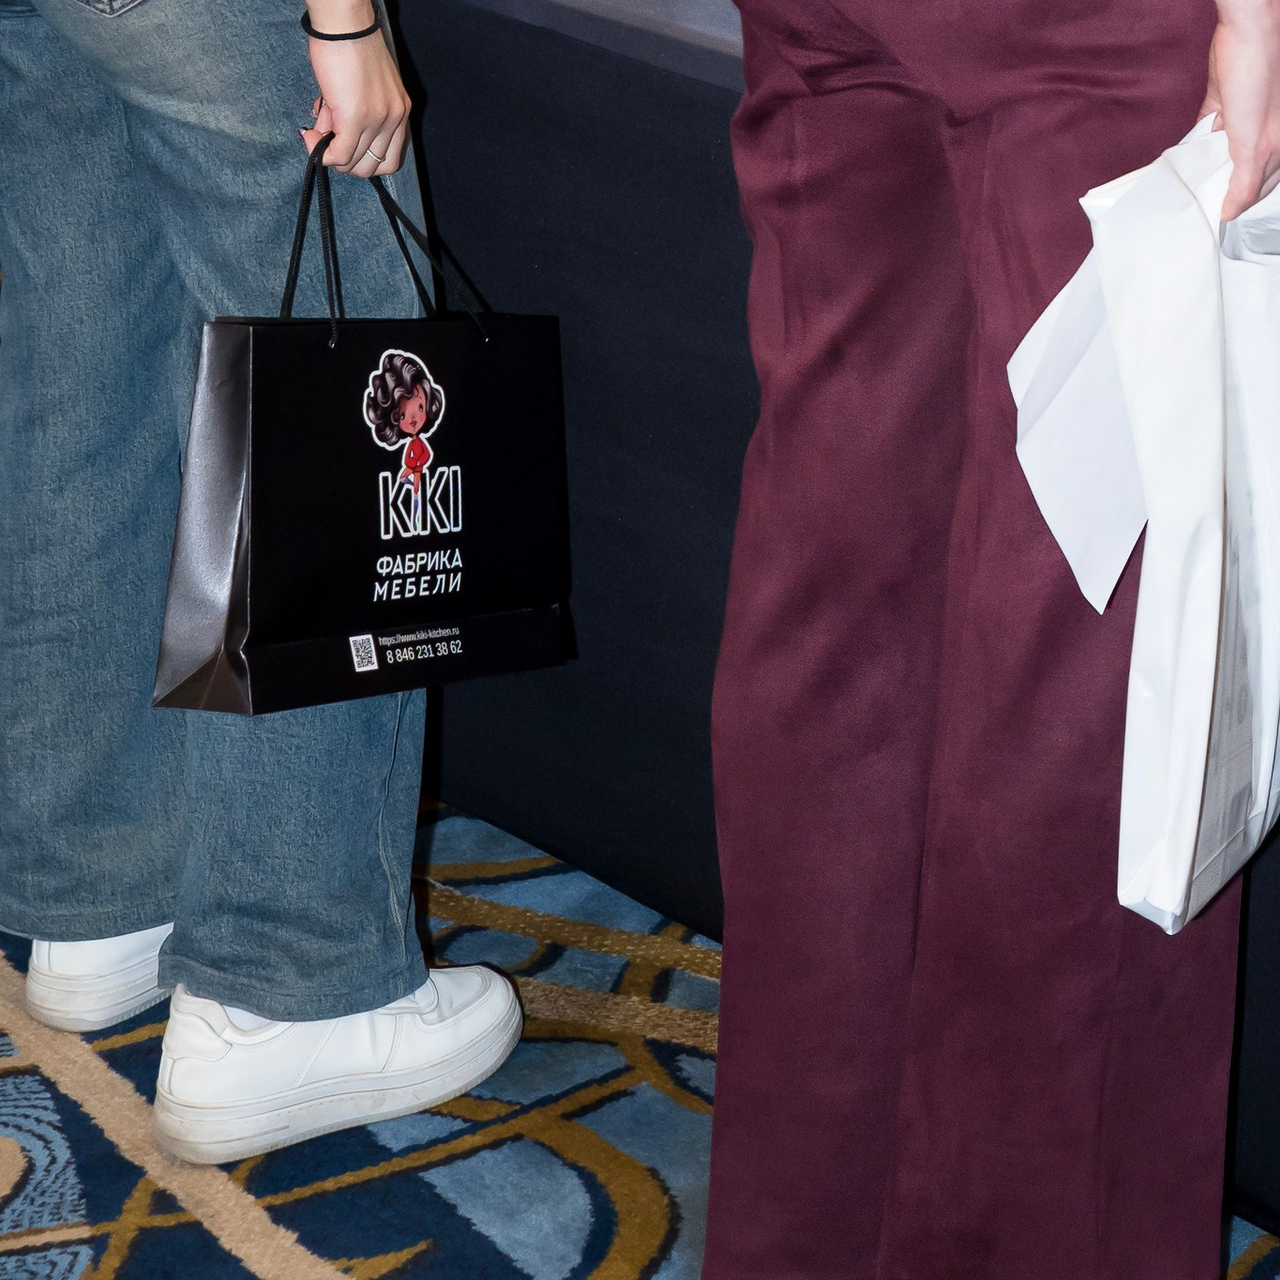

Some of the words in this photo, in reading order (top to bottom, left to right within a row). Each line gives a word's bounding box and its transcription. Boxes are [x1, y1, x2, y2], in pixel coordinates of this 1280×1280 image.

[376, 548, 463, 577] ФАБРИКА
[373, 572, 462, 602] МЕБЕЛИ
[378, 626, 460, 646] https://www.kiki-kitchen.ru
[386, 649, 394, 664] 8
[395, 646, 415, 662] 846
[416, 643, 435, 659] 231
[436, 641, 449, 657] 38
[450, 639, 463, 654] 62
